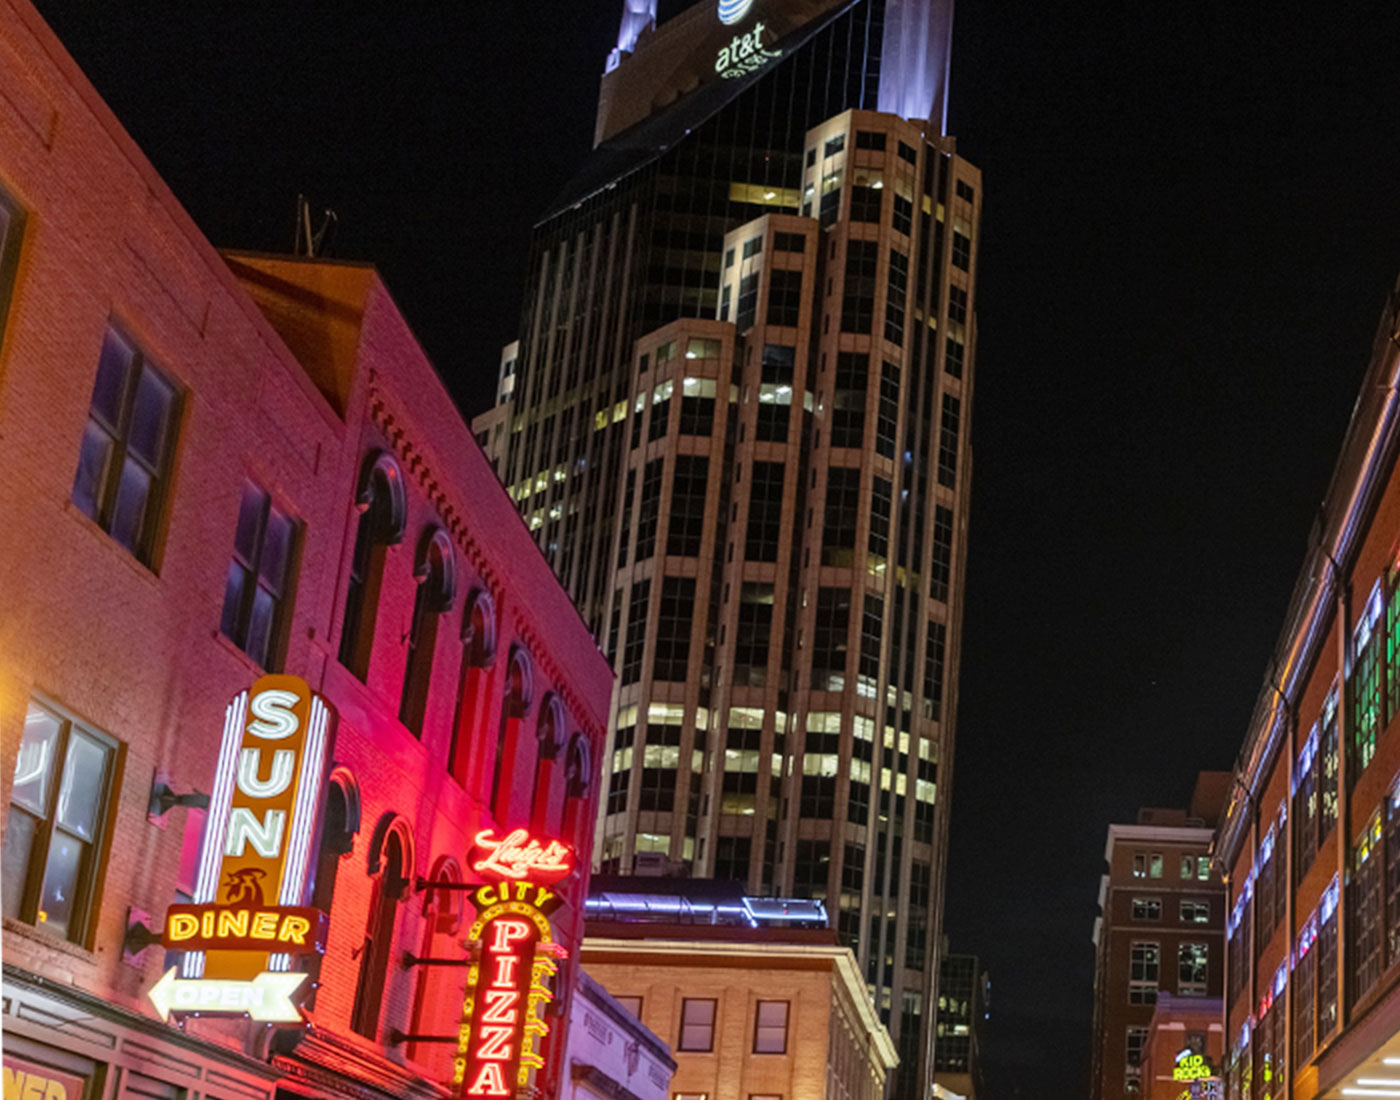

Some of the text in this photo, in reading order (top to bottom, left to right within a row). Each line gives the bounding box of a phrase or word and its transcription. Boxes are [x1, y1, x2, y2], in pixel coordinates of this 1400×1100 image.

[715, 22, 765, 72] at&t
[224, 689, 301, 858] SUN
[476, 880, 554, 908] CITY
[169, 909, 311, 945] DINER
[173, 984, 265, 1008] OPEN
[467, 919, 531, 1096] PIZZA
[1179, 1054, 1204, 1068] KID
